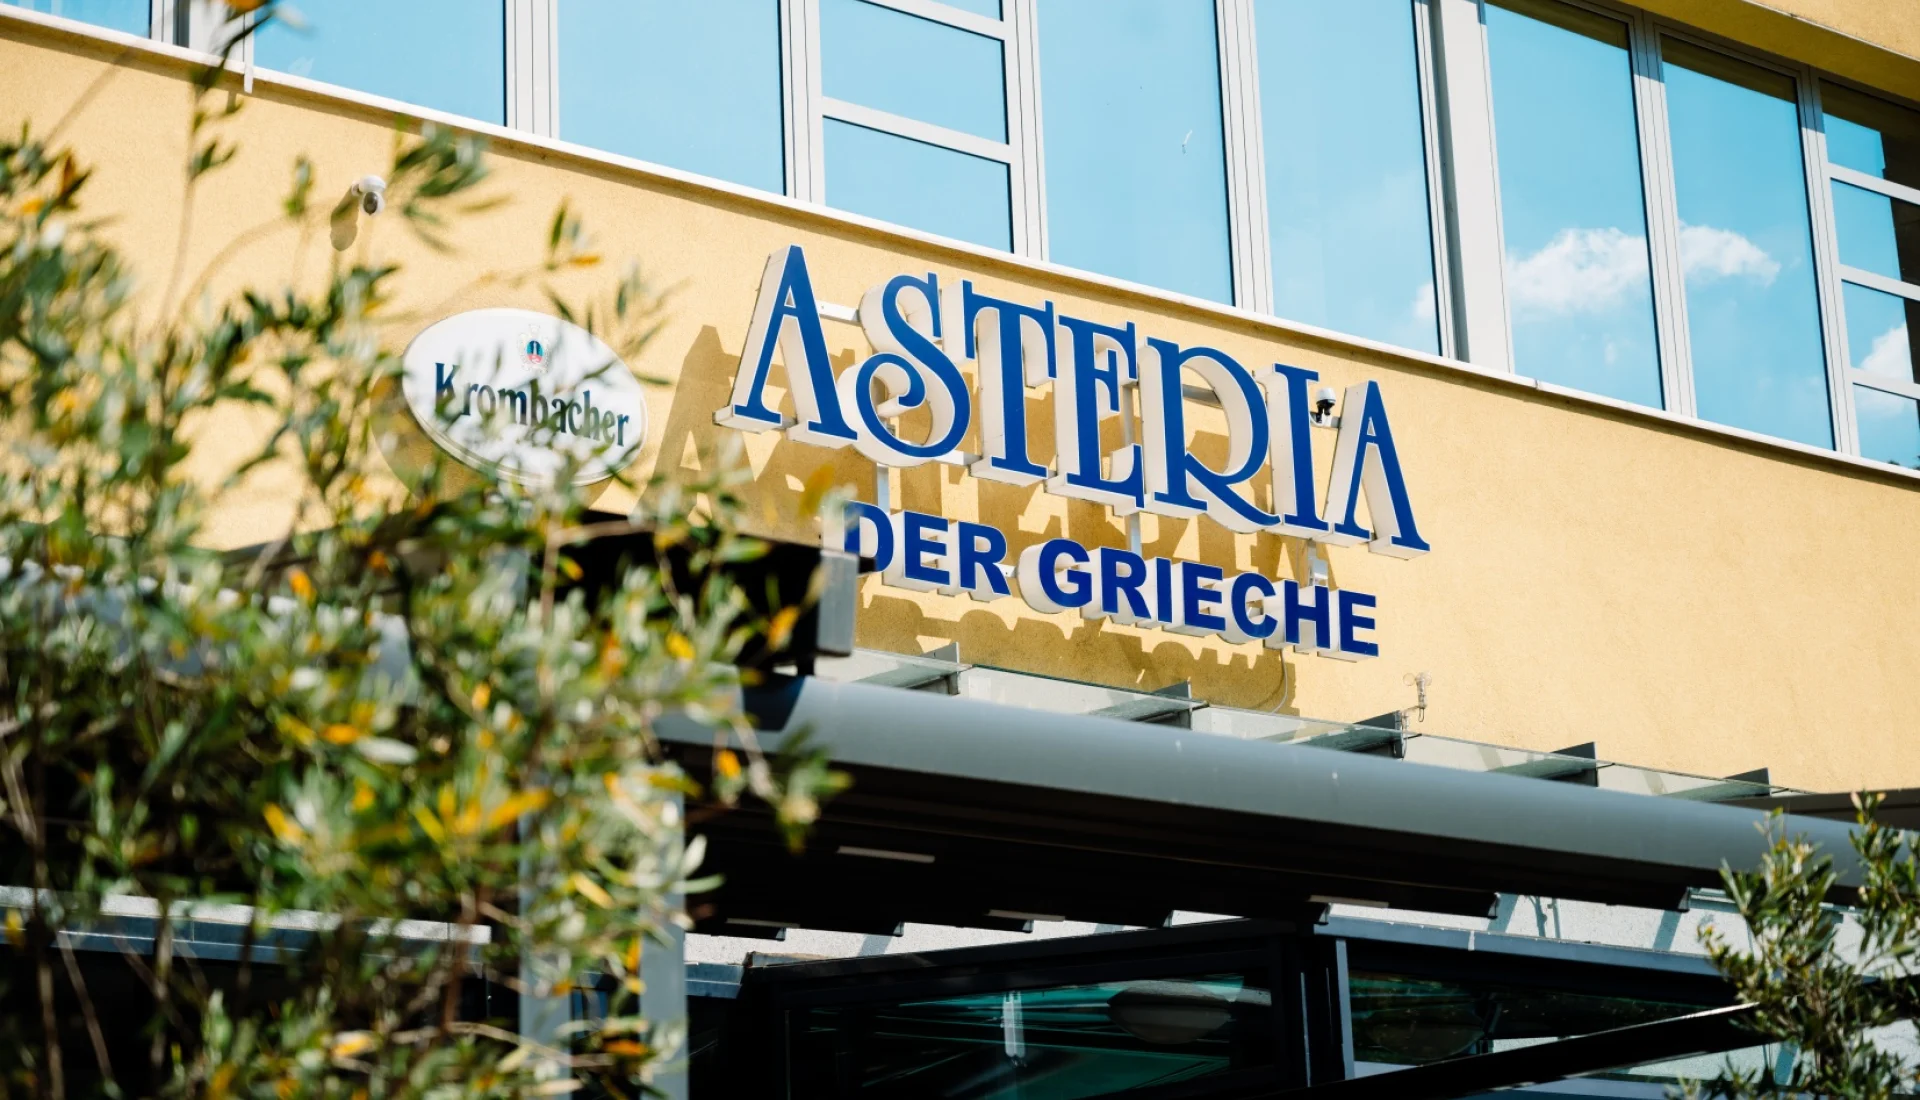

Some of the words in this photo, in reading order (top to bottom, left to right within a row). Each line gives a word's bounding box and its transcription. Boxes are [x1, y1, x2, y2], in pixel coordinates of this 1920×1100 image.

[434, 361, 630, 447] Krombacher
[733, 245, 1431, 553] ASTERIA
[843, 500, 1011, 596] DER
[1037, 538, 1379, 657] GRIECHE
